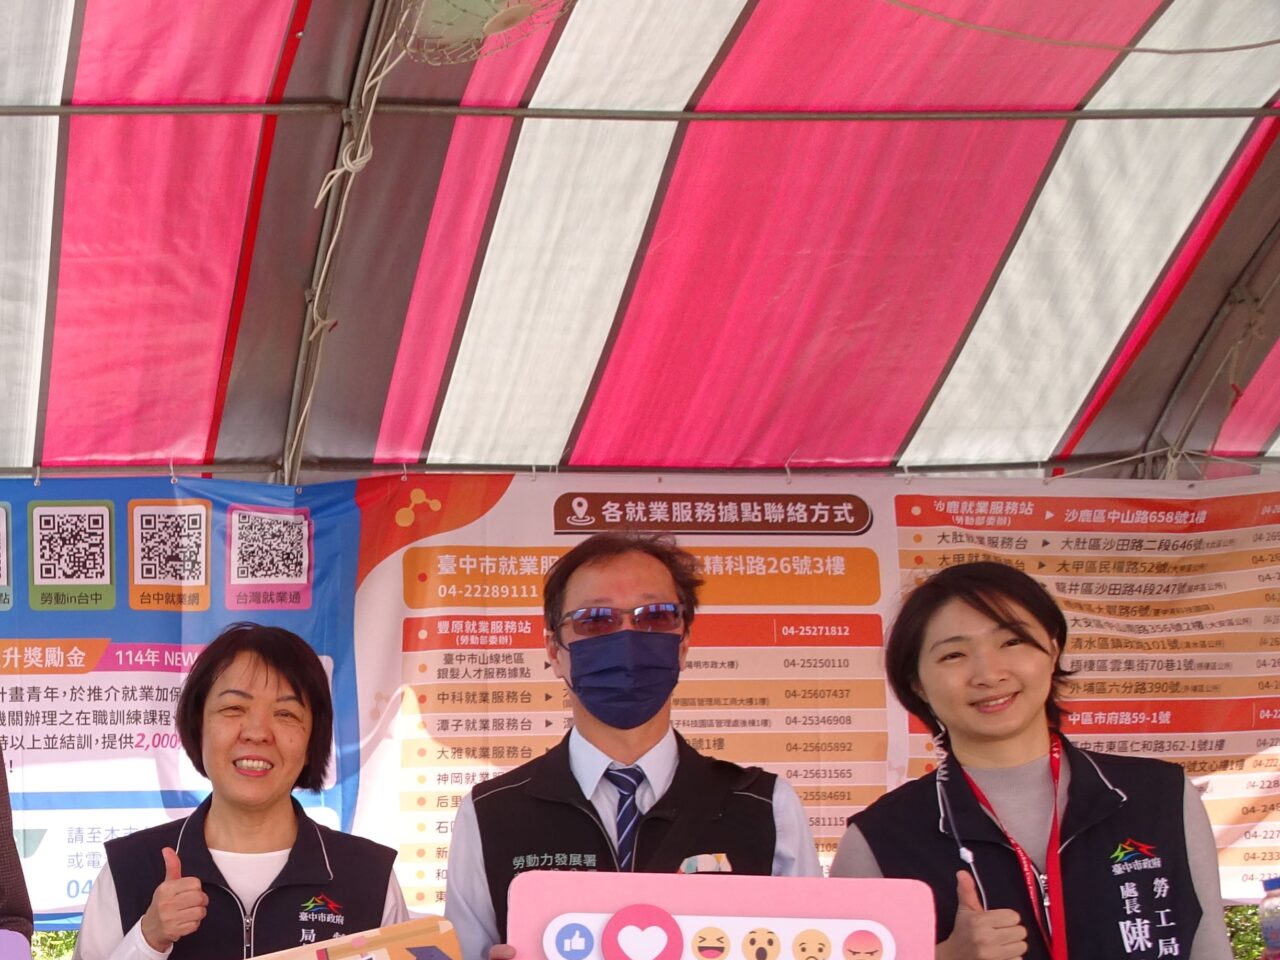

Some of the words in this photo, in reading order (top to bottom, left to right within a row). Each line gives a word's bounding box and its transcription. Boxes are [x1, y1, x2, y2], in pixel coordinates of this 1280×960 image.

[601, 501, 855, 524] 各就業服務據點聯絡方式
[695, 556, 845, 576] 精科路26號3樓
[40, 591, 103, 606] 勞動in台中
[138, 591, 200, 606] 台中就業網
[235, 591, 302, 606] 台灣就業通
[437, 584, 539, 599] 04-22289111
[437, 620, 532, 635] 豐原就業服務站
[781, 625, 850, 636] 04-25271812
[115, 649, 160, 667] 114年
[443, 652, 524, 665] 臺中市山線地區
[783, 658, 850, 669] 04-25250110
[436, 667, 531, 679] 銀髮人才服務據點
[437, 690, 532, 704] 中科就業服務台
[436, 718, 533, 732] 潭子就業服務台
[785, 716, 852, 726] 04-25346908
[436, 746, 533, 760] 大雅就業服務台
[1111, 857, 1162, 876] 臺中市政府
[298, 911, 345, 925] 臺中市政府
